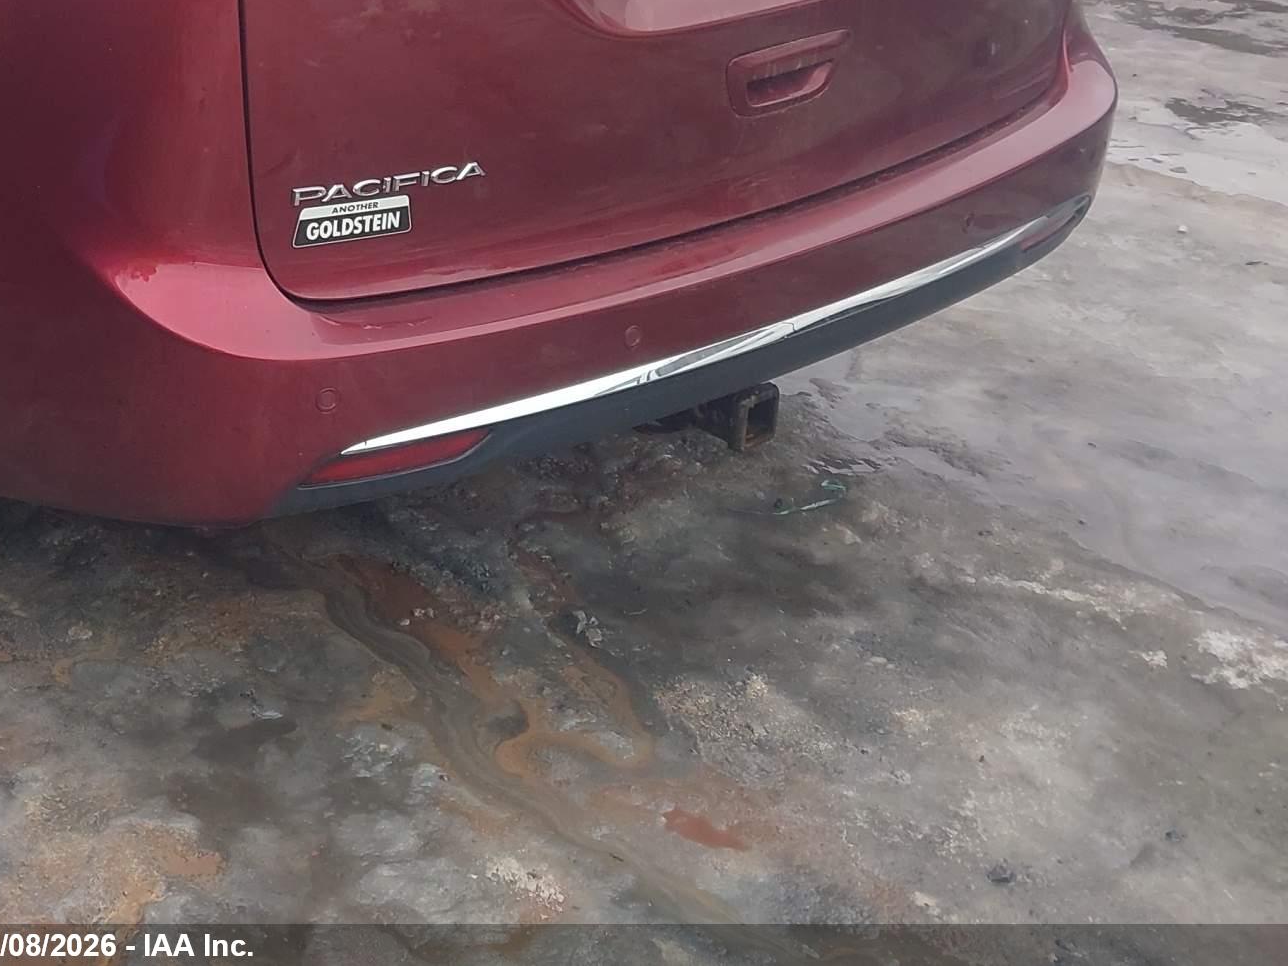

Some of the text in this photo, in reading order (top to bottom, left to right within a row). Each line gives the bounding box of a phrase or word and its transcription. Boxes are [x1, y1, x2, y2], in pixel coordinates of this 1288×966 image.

[292, 161, 487, 206] PACIFICA
[331, 201, 380, 215] ANOTHER
[306, 211, 401, 241] GOLDSTEIN
